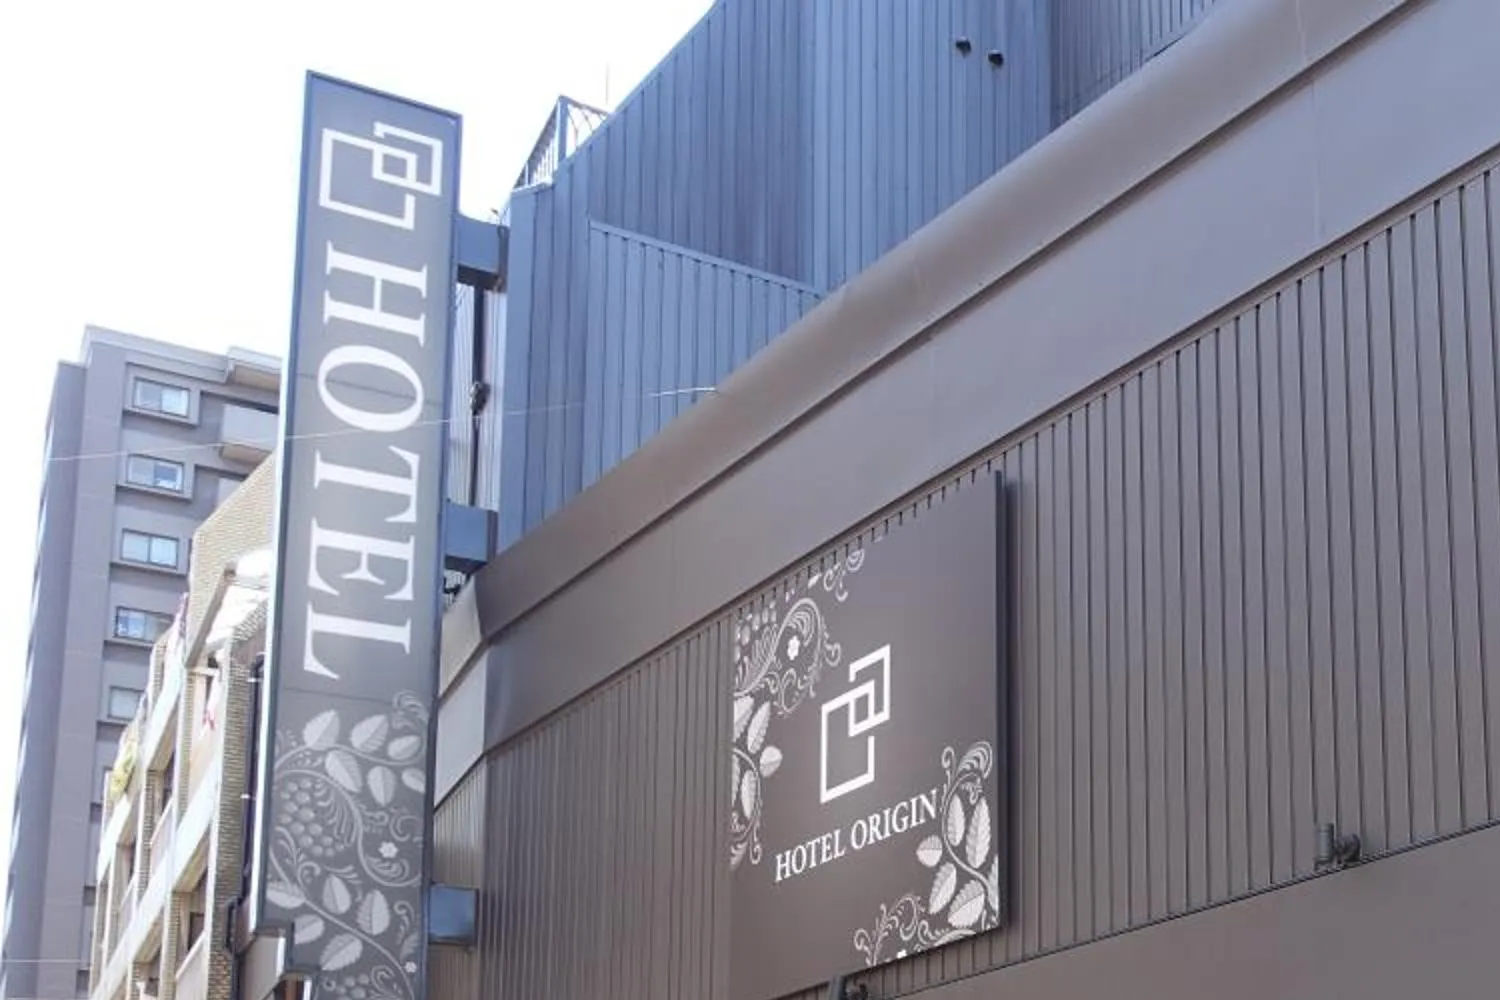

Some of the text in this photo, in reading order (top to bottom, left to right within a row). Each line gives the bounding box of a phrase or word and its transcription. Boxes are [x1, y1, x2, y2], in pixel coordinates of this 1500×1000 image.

[303, 240, 428, 682] HOTEL
[774, 788, 938, 883] HOTEL ORIGIN
